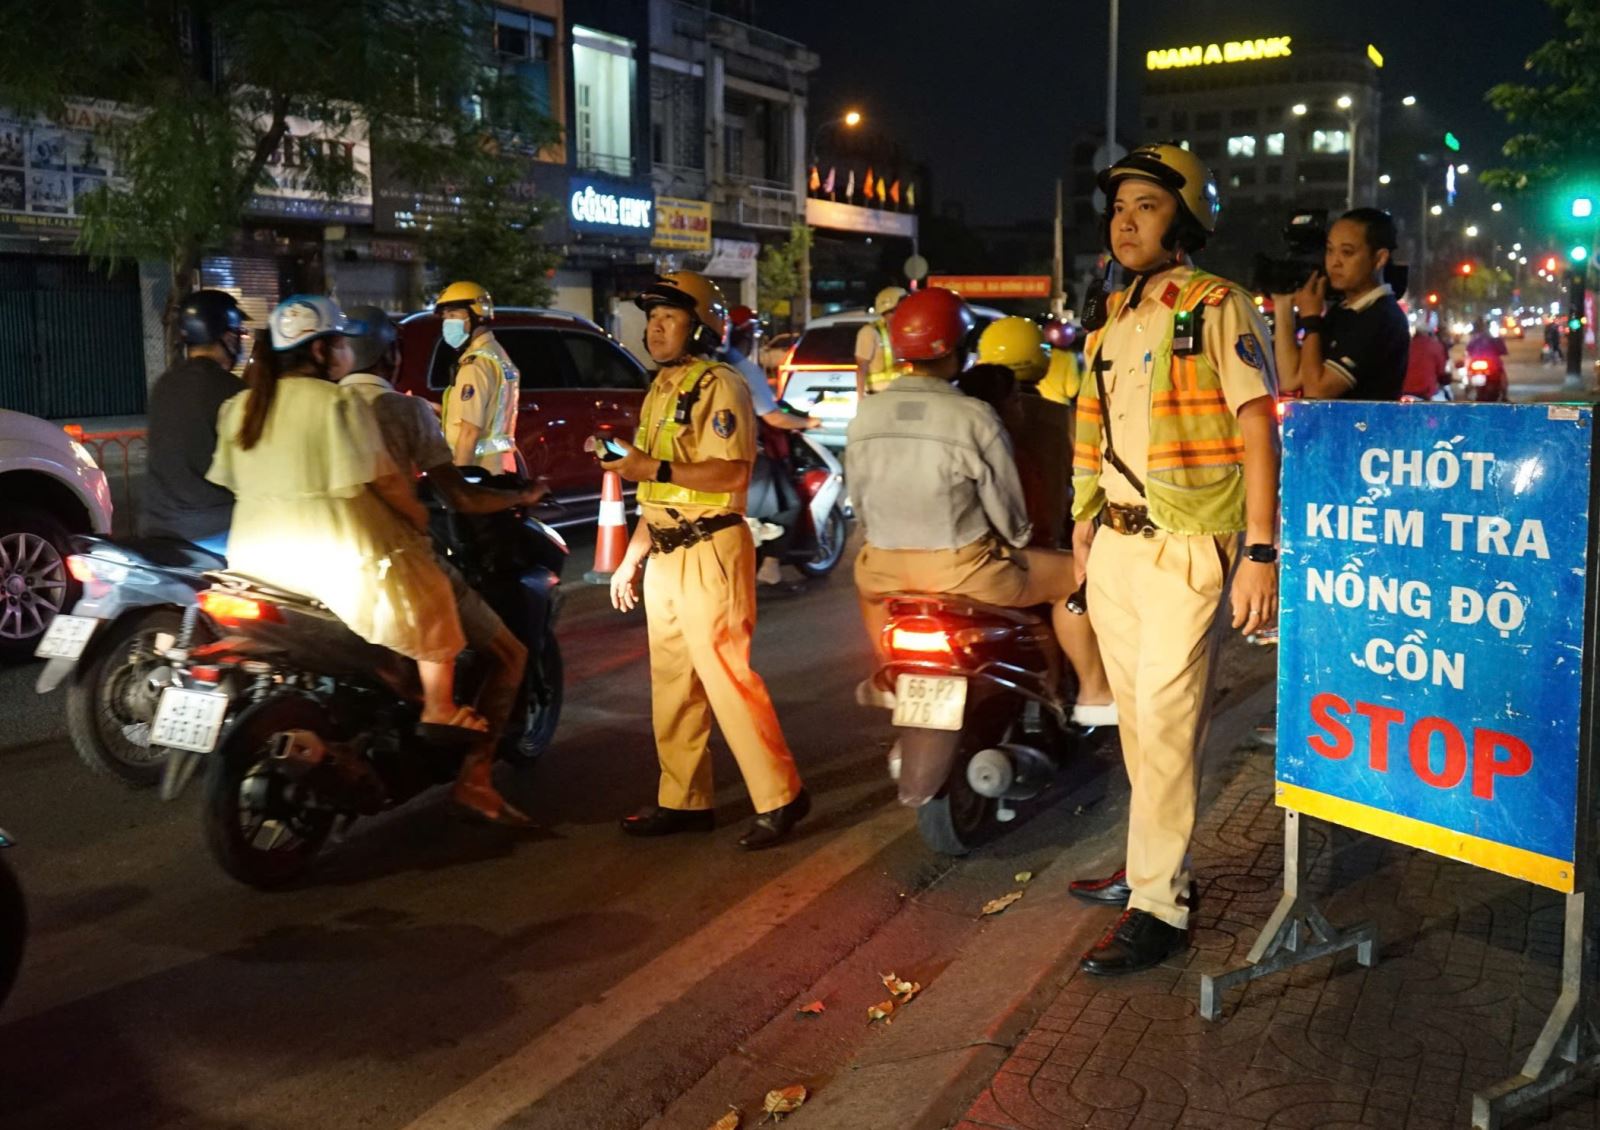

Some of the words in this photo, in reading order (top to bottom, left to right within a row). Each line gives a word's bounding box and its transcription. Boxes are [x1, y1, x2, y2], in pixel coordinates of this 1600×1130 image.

[1203, 43, 1223, 65] A
[1224, 36, 1291, 62] BANK
[1360, 435, 1494, 490] CHỐT
[1306, 488, 1424, 548] KIỂM
[1442, 513, 1550, 559] TRA
[1307, 557, 1431, 619] NỒNG
[1449, 581, 1524, 638] ĐỘ
[1365, 629, 1464, 690] CỒN
[1307, 692, 1533, 800] STOP
